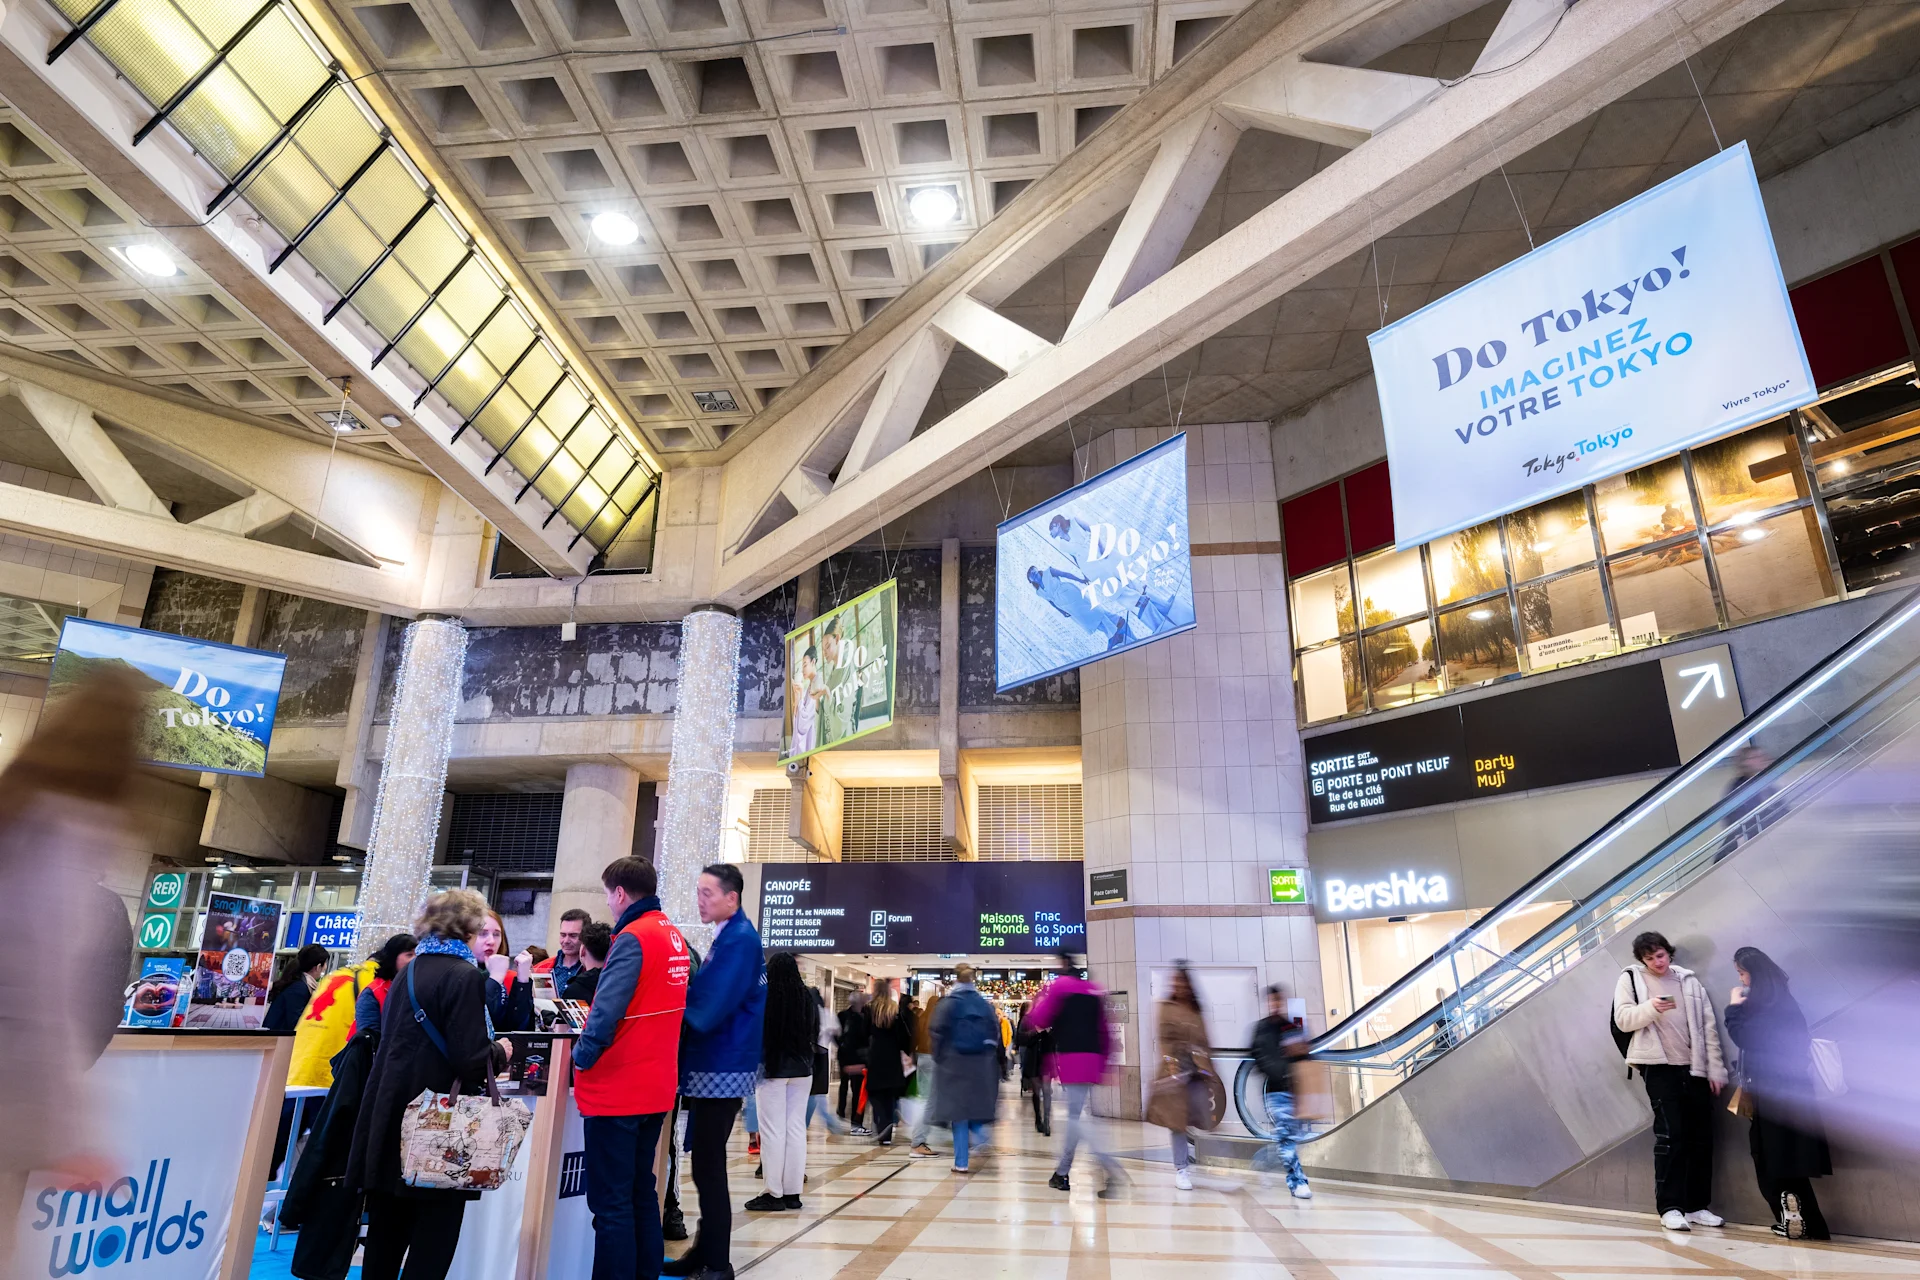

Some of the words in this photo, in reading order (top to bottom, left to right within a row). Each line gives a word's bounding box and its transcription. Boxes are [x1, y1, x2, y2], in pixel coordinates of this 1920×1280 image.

[1432, 339, 1506, 391] Do
[1521, 246, 1690, 348] Tokyo!
[1480, 318, 1652, 408] IMAGINEZ
[1455, 386, 1562, 444] VOTRE
[1568, 332, 1692, 398] TOKYO
[1722, 396, 1750, 410] Vivre
[1574, 426, 1634, 456] Tokyo
[1086, 522, 1140, 562] Do
[1081, 523, 1180, 610] Tokyo!
[836, 640, 868, 670] Do
[832, 644, 888, 706] Tokyo!
[172, 667, 230, 708] Do
[158, 703, 265, 730] Tokyo!
[1311, 756, 1355, 776] SORTIE
[1358, 757, 1378, 767] SALIDA
[1474, 753, 1515, 772] Darty
[1328, 774, 1363, 790] PORTE
[1366, 773, 1378, 783] DU
[1381, 764, 1412, 780] PONT
[1417, 756, 1450, 774] NEUF
[1477, 770, 1506, 789] Muji
[1343, 790, 1353, 800] de
[1355, 788, 1363, 797] la
[1366, 784, 1382, 795] Cité
[1330, 803, 1345, 812] Rue
[1348, 800, 1358, 809] de
[1361, 795, 1384, 807] Rivoli
[153, 882, 178, 895] RER
[765, 878, 811, 891] CANOPÉE
[1326, 870, 1448, 912] Bershka
[214, 899, 242, 914] small
[243, 902, 277, 917] worlds
[764, 895, 794, 905] PATIO
[888, 914, 912, 923] Forum
[980, 913, 1024, 923] Maisons
[1035, 911, 1060, 921] Fnac
[145, 920, 164, 940] M
[312, 932, 335, 945] Les
[980, 925, 990, 934] du
[993, 924, 1030, 934] Monde
[1035, 924, 1049, 934] Go
[1052, 922, 1084, 936] Sport
[980, 937, 1004, 946] Zara
[1035, 937, 1060, 946] H&M
[32, 1158, 170, 1231] small
[48, 1200, 208, 1279] worlds
